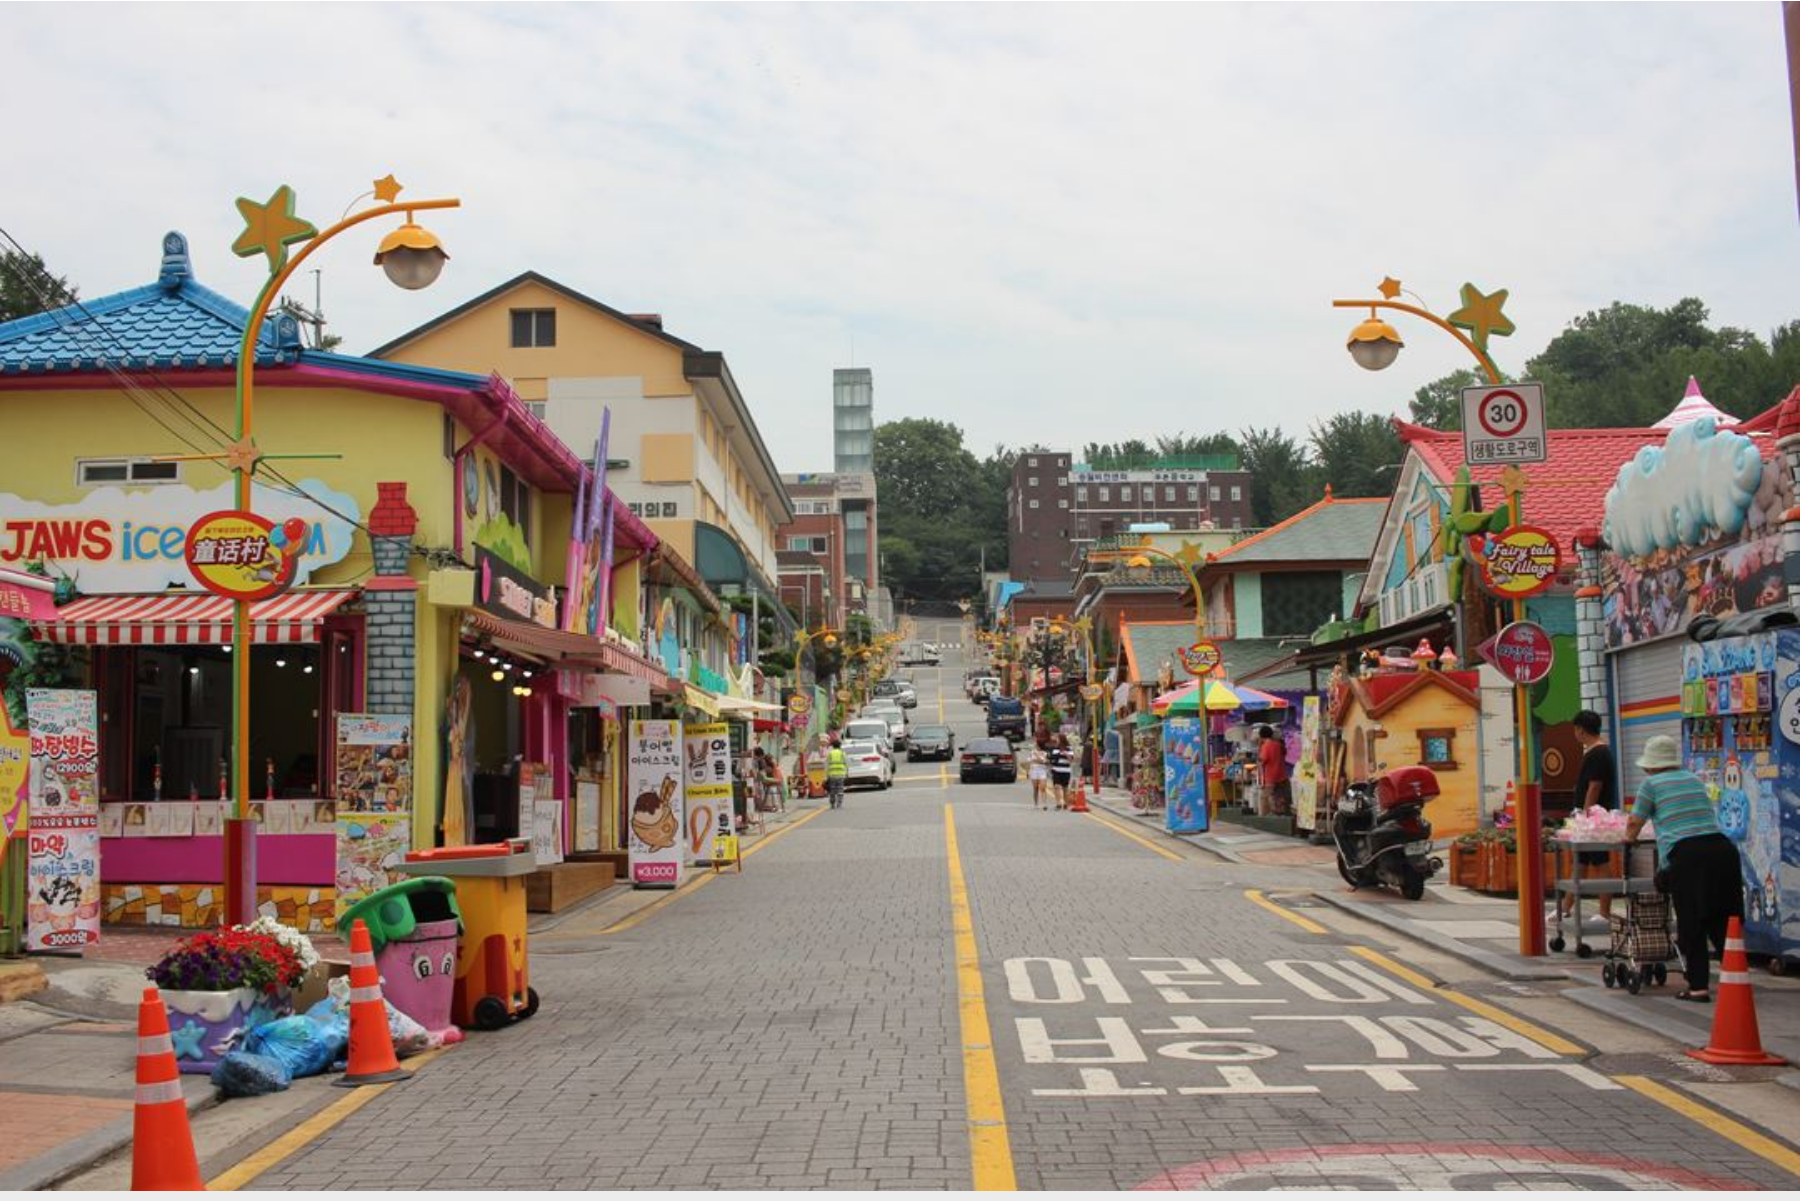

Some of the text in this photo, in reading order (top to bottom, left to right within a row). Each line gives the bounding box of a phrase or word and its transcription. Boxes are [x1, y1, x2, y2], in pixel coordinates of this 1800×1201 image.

[1490, 404, 1517, 423] 30
[1474, 441, 1538, 458] 생활도로구역
[1, 519, 184, 562] JAWS ice
[192, 537, 267, 564] 童话村
[1488, 543, 1556, 561] Fairy tale
[1502, 559, 1555, 578] Village
[639, 739, 673, 752] 붕어빵
[631, 755, 680, 767] 아이스크림
[31, 834, 66, 856] 마약
[50, 931, 88, 945] 3000원
[1003, 956, 1437, 1004] 어린이
[1015, 1015, 1626, 1097] 보호구역
